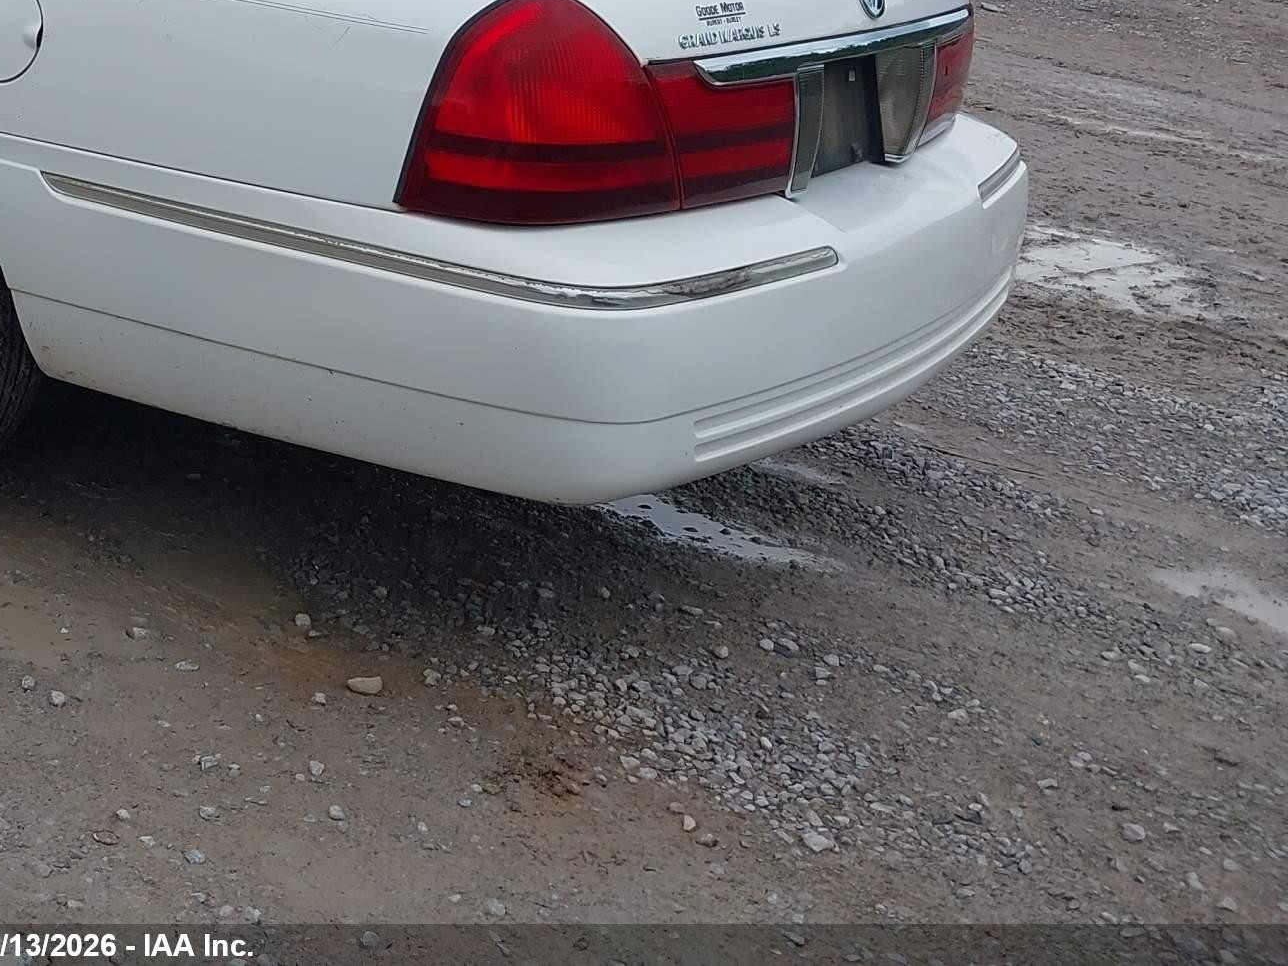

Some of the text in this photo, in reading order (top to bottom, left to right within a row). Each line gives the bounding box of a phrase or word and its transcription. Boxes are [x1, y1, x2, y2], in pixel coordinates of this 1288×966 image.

[720, 1, 745, 13] MOTOR
[678, 32, 718, 50] GRAND
[767, 22, 781, 37] LS
